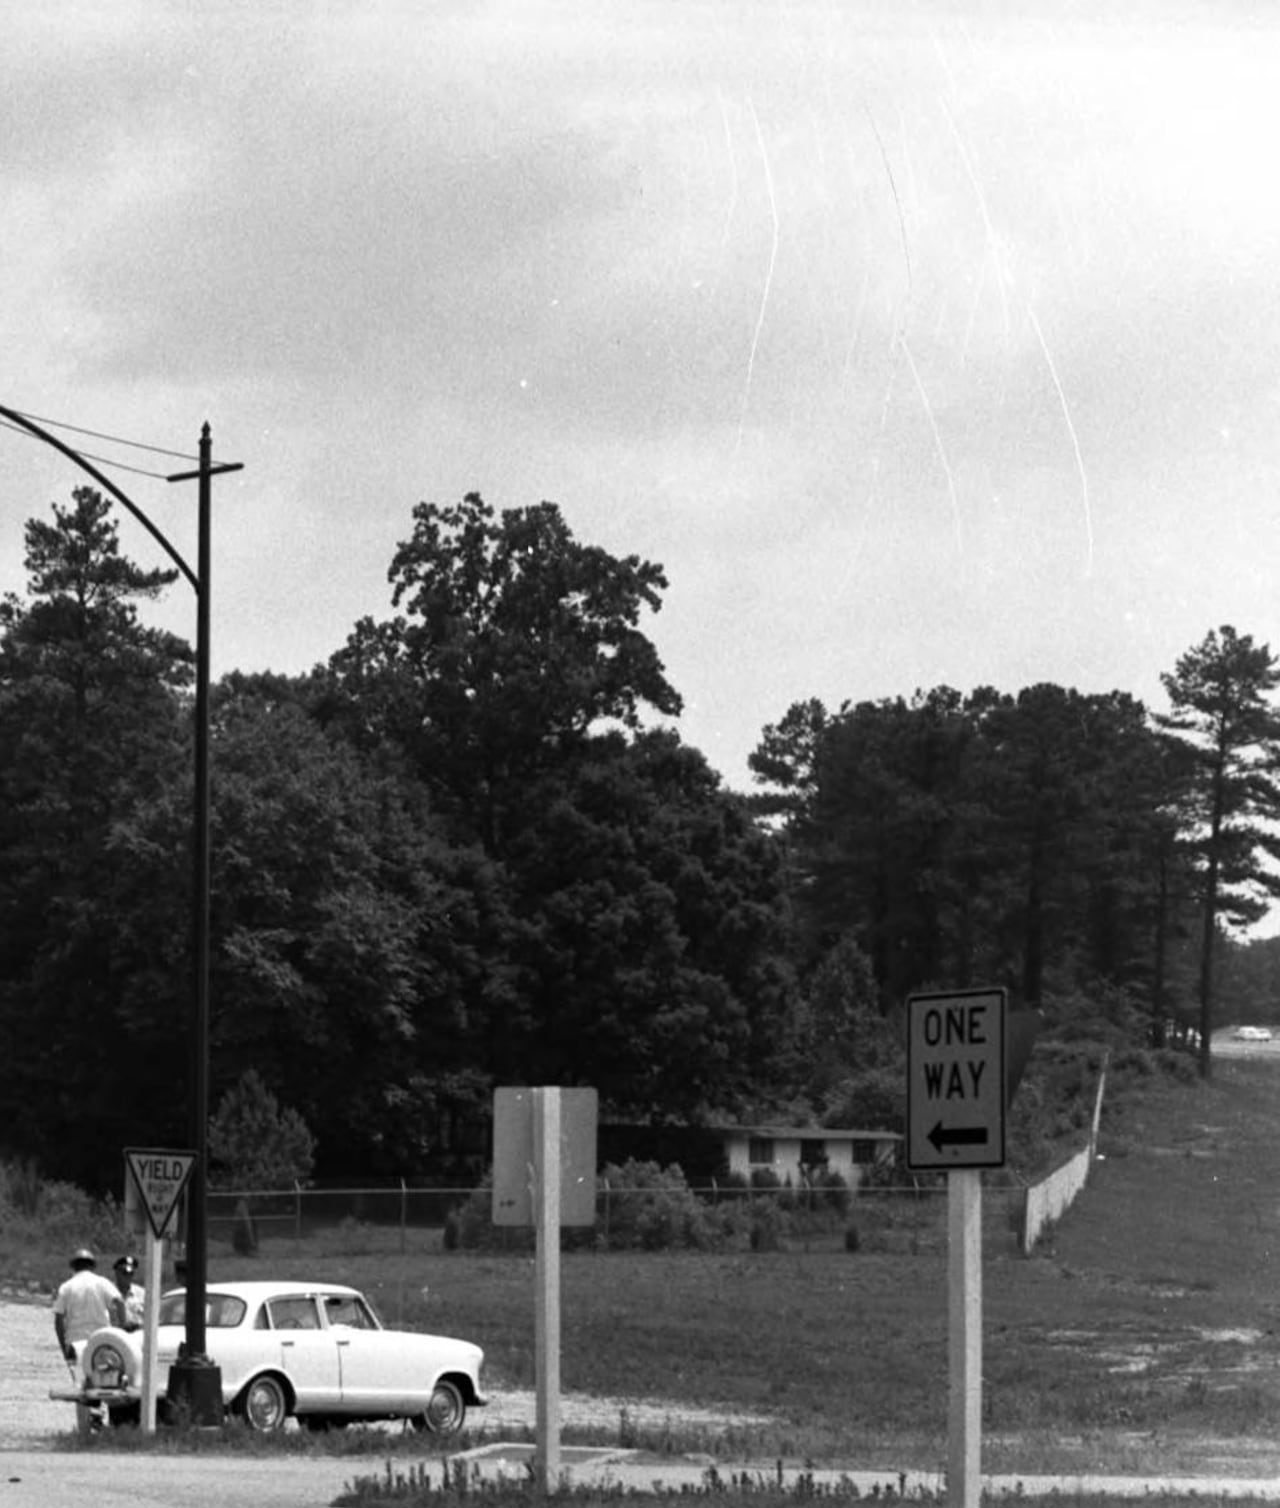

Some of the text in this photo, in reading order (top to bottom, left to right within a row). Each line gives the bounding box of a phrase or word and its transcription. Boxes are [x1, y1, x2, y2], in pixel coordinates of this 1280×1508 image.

[924, 1006, 987, 1046] ONE
[924, 1061, 986, 1100] WAY
[137, 1159, 183, 1181] YIELD
